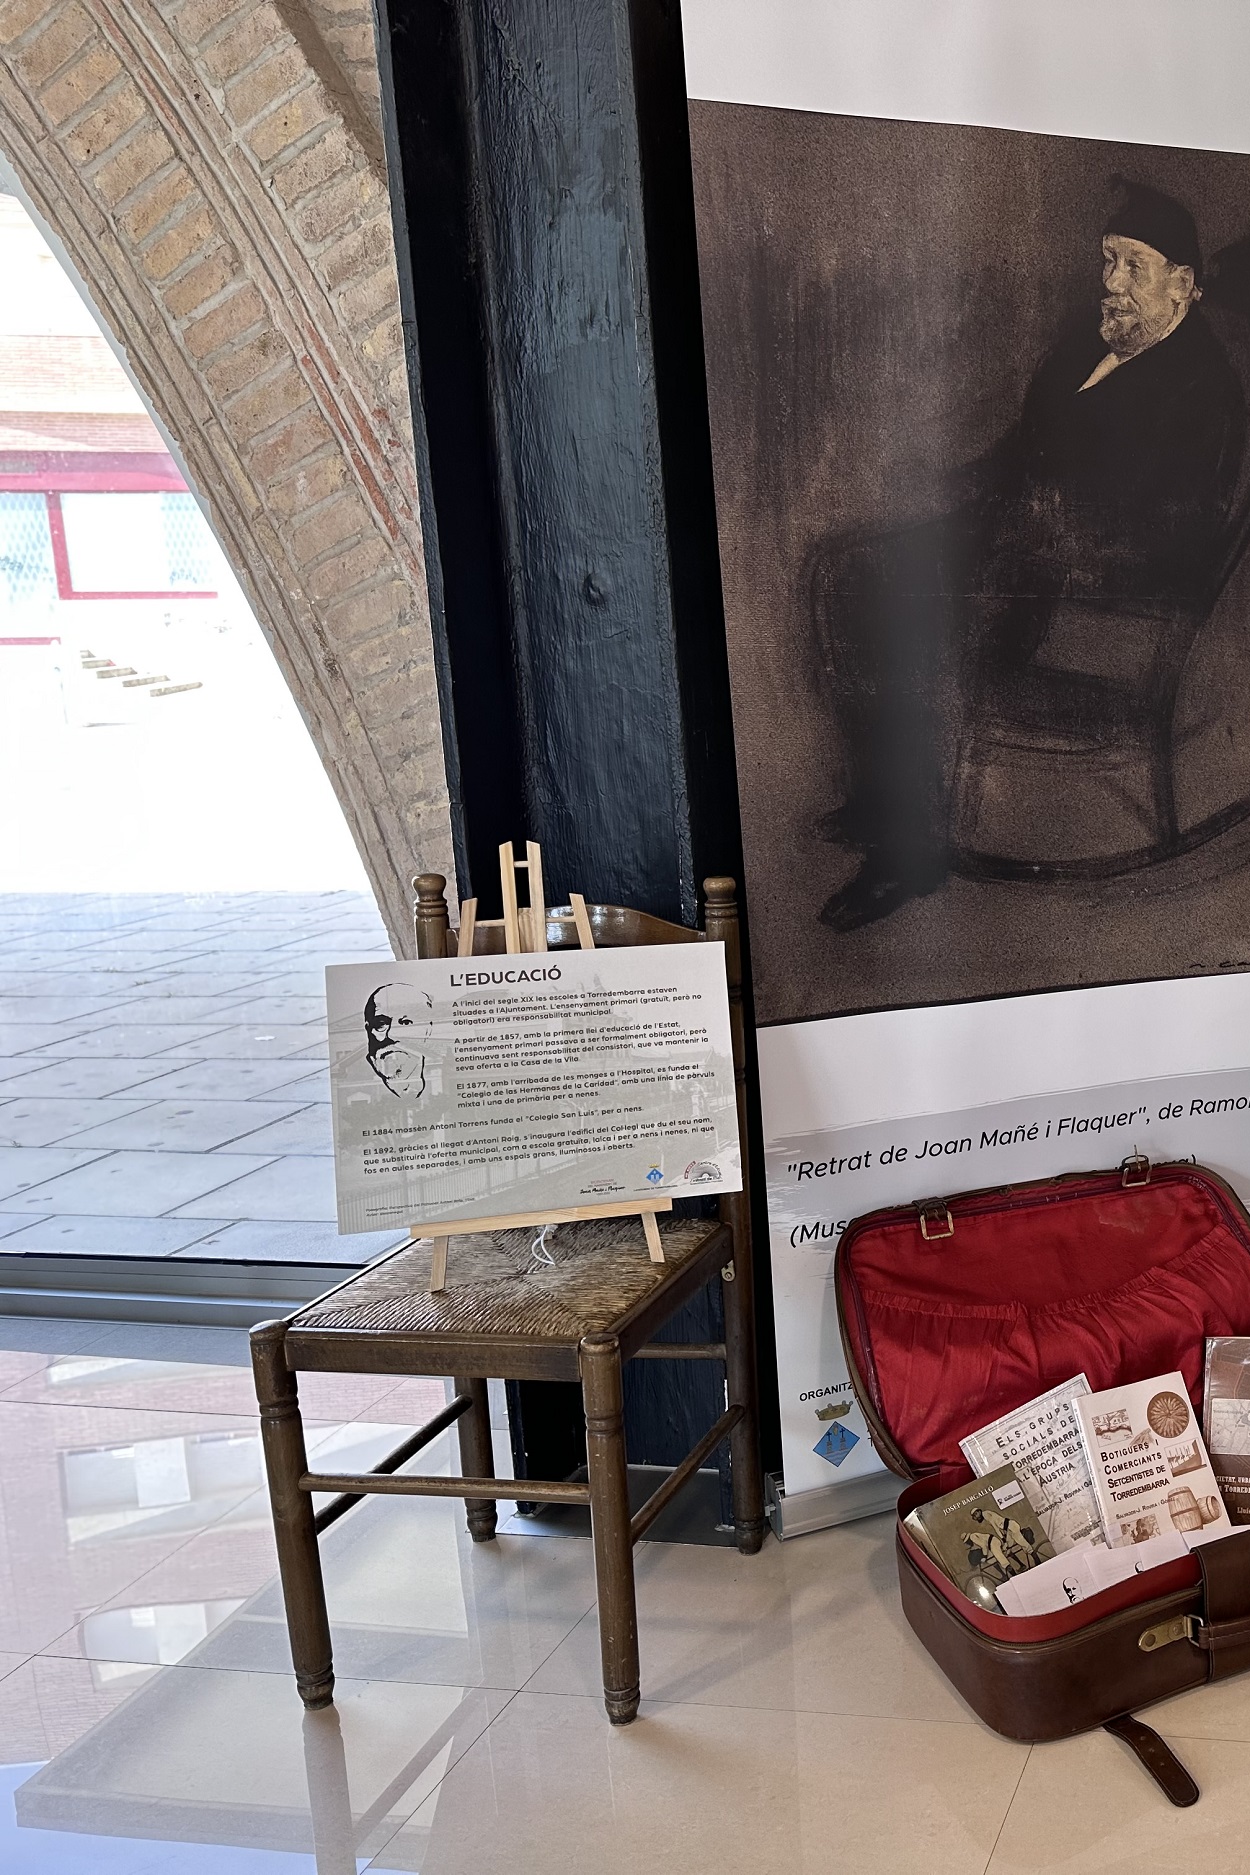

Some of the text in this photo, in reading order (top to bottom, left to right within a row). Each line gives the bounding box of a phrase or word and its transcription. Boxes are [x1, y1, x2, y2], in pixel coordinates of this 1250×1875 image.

[450, 964, 561, 987] L'EDUCACIÓ
[452, 1008, 486, 1016] situades
[496, 1004, 547, 1014] l'Ajuntament.
[550, 999, 608, 1010] L'ensenyament
[610, 997, 637, 1006] primari
[640, 995, 670, 1004] (gratuït,
[497, 997, 518, 1005] segle
[587, 988, 645, 997] Torredembarra
[452, 1017, 494, 1027] obligatori)
[512, 1011, 571, 1022] responsabilitat
[454, 1042, 512, 1054] l'ensenyament
[514, 1040, 543, 1049] primari
[545, 1038, 578, 1046] passava
[601, 1032, 646, 1041] formalment
[648, 1029, 687, 1038] obligatori,
[689, 1027, 706, 1035] però
[462, 1035, 485, 1044] partir
[500, 1033, 521, 1041] 1857,
[553, 1028, 583, 1037] primera
[599, 1023, 640, 1032] d'educació
[654, 1020, 680, 1029] l'Estat,
[454, 1053, 499, 1062] continuava
[521, 1046, 579, 1058] responsabilitat
[595, 1042, 635, 1051] consistori,
[665, 1037, 699, 1045] mantenir
[520, 1058, 540, 1066] Casa
[786, 1149, 873, 1182] "Retrat
[878, 1142, 909, 1166] de
[913, 1137, 973, 1160] Joan
[979, 1119, 1040, 1149] Mañé
[1045, 1118, 1052, 1138] i
[1056, 1103, 1153, 1144] Flaquer",
[1157, 1100, 1185, 1121] de
[995, 1403, 1070, 1448] ELS GRUPS
[1003, 1415, 1075, 1460] SOCIALS DE
[1012, 1428, 1080, 1471] TORREDEMBARRA
[1062, 1441, 1083, 1458] DELS
[1101, 1442, 1149, 1462] BOTIGUERS
[1104, 1452, 1162, 1475] COMERCIANTS
[1107, 1468, 1154, 1488] SETCENTISTES
[1156, 1465, 1166, 1474] DE
[1110, 1478, 1170, 1502] TORREDEMBARRA
[942, 1501, 961, 1516] JOSEP
